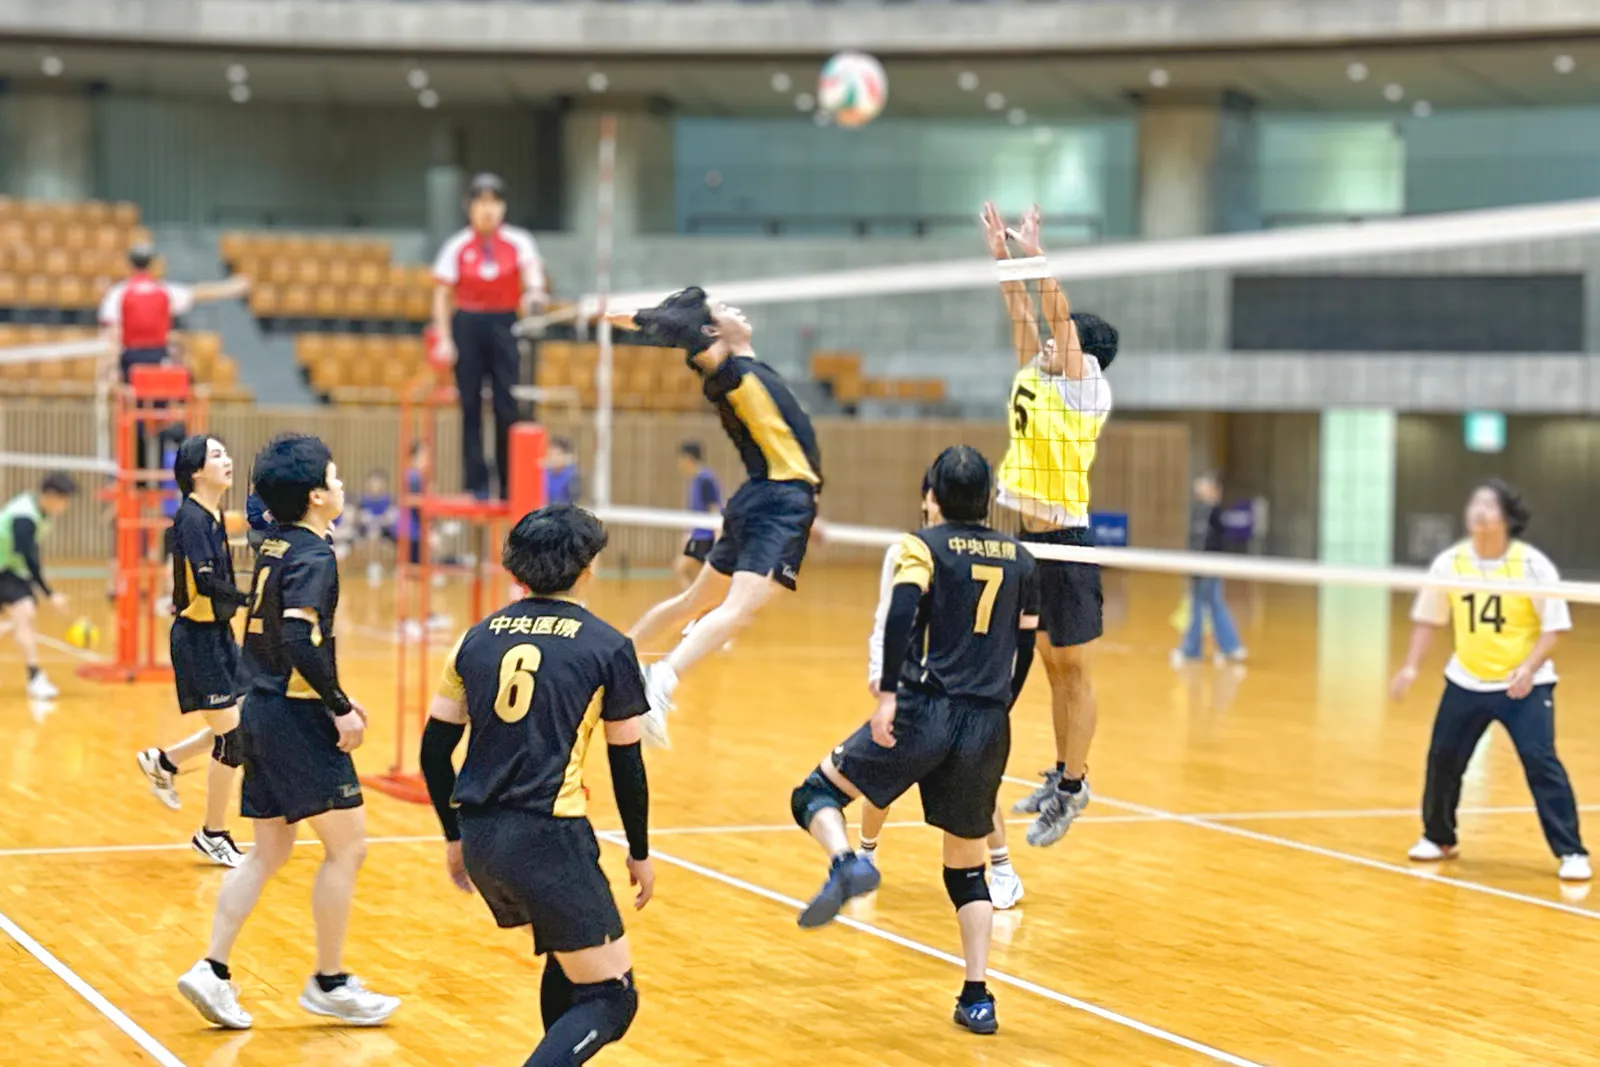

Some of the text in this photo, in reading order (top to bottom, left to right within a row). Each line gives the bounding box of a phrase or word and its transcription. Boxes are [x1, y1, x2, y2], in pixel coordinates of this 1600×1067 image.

[488, 615, 583, 639] 中央医療
[971, 563, 1004, 635] 7
[1461, 591, 1506, 634] 14
[494, 643, 542, 724] 6
